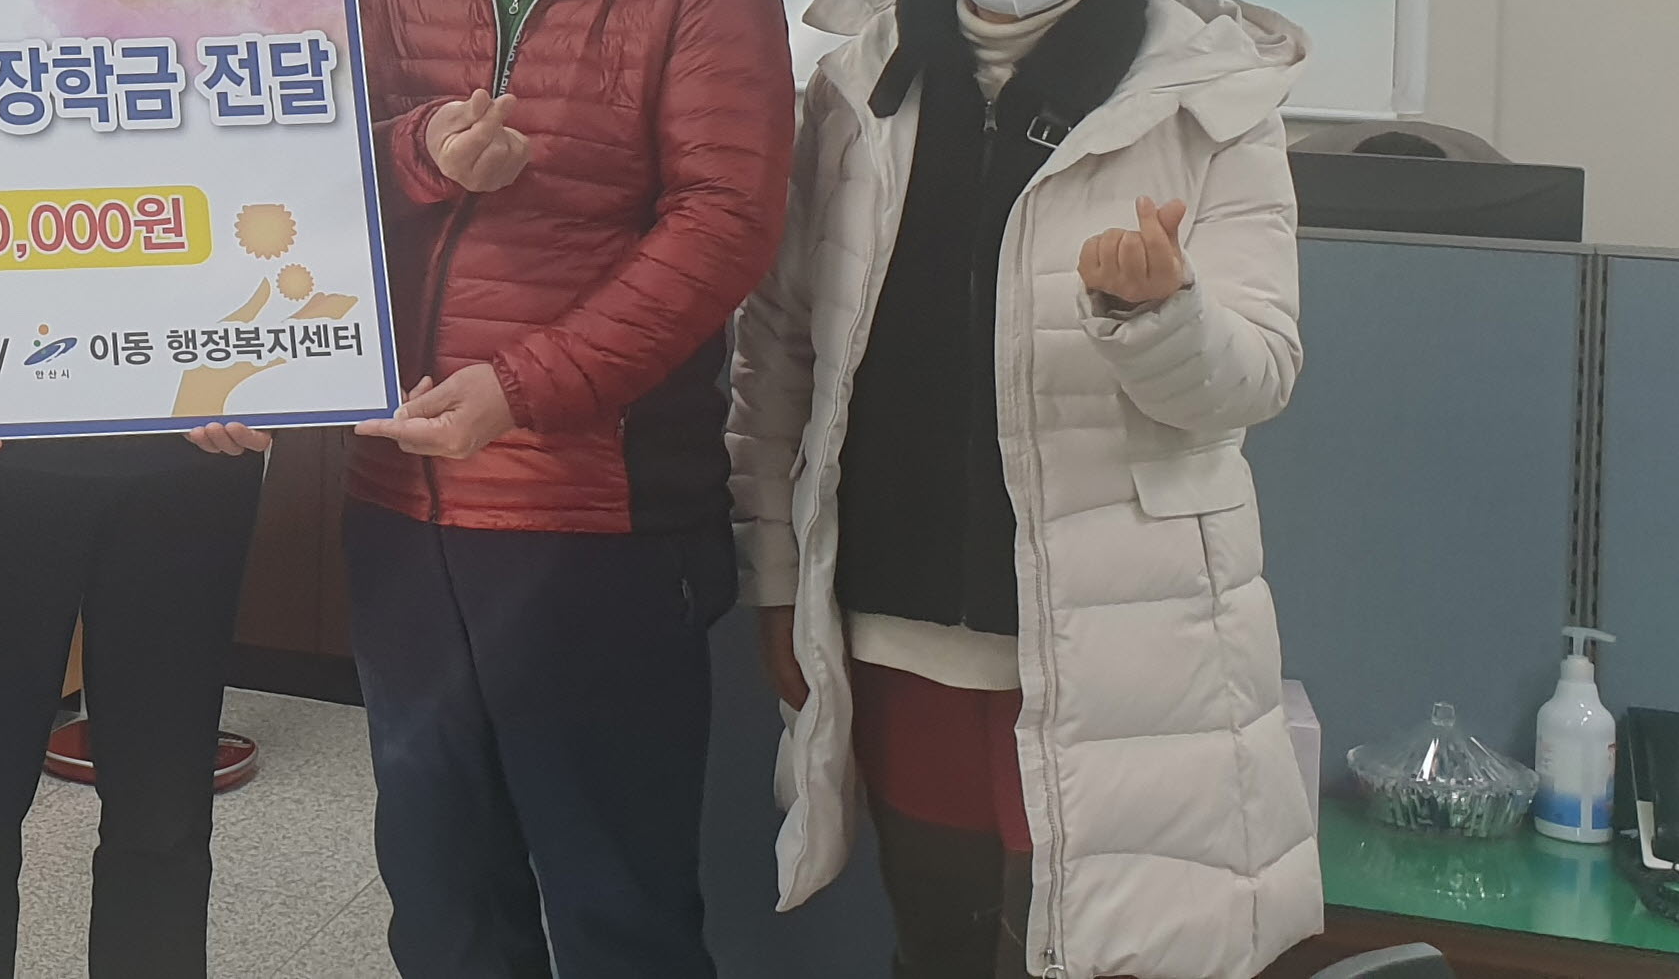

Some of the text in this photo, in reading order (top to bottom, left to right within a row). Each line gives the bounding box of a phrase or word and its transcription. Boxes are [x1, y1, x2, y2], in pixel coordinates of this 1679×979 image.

[203, 38, 329, 118] 전달
[89, 331, 154, 366] 이동
[166, 322, 363, 364] 행정복지센터
